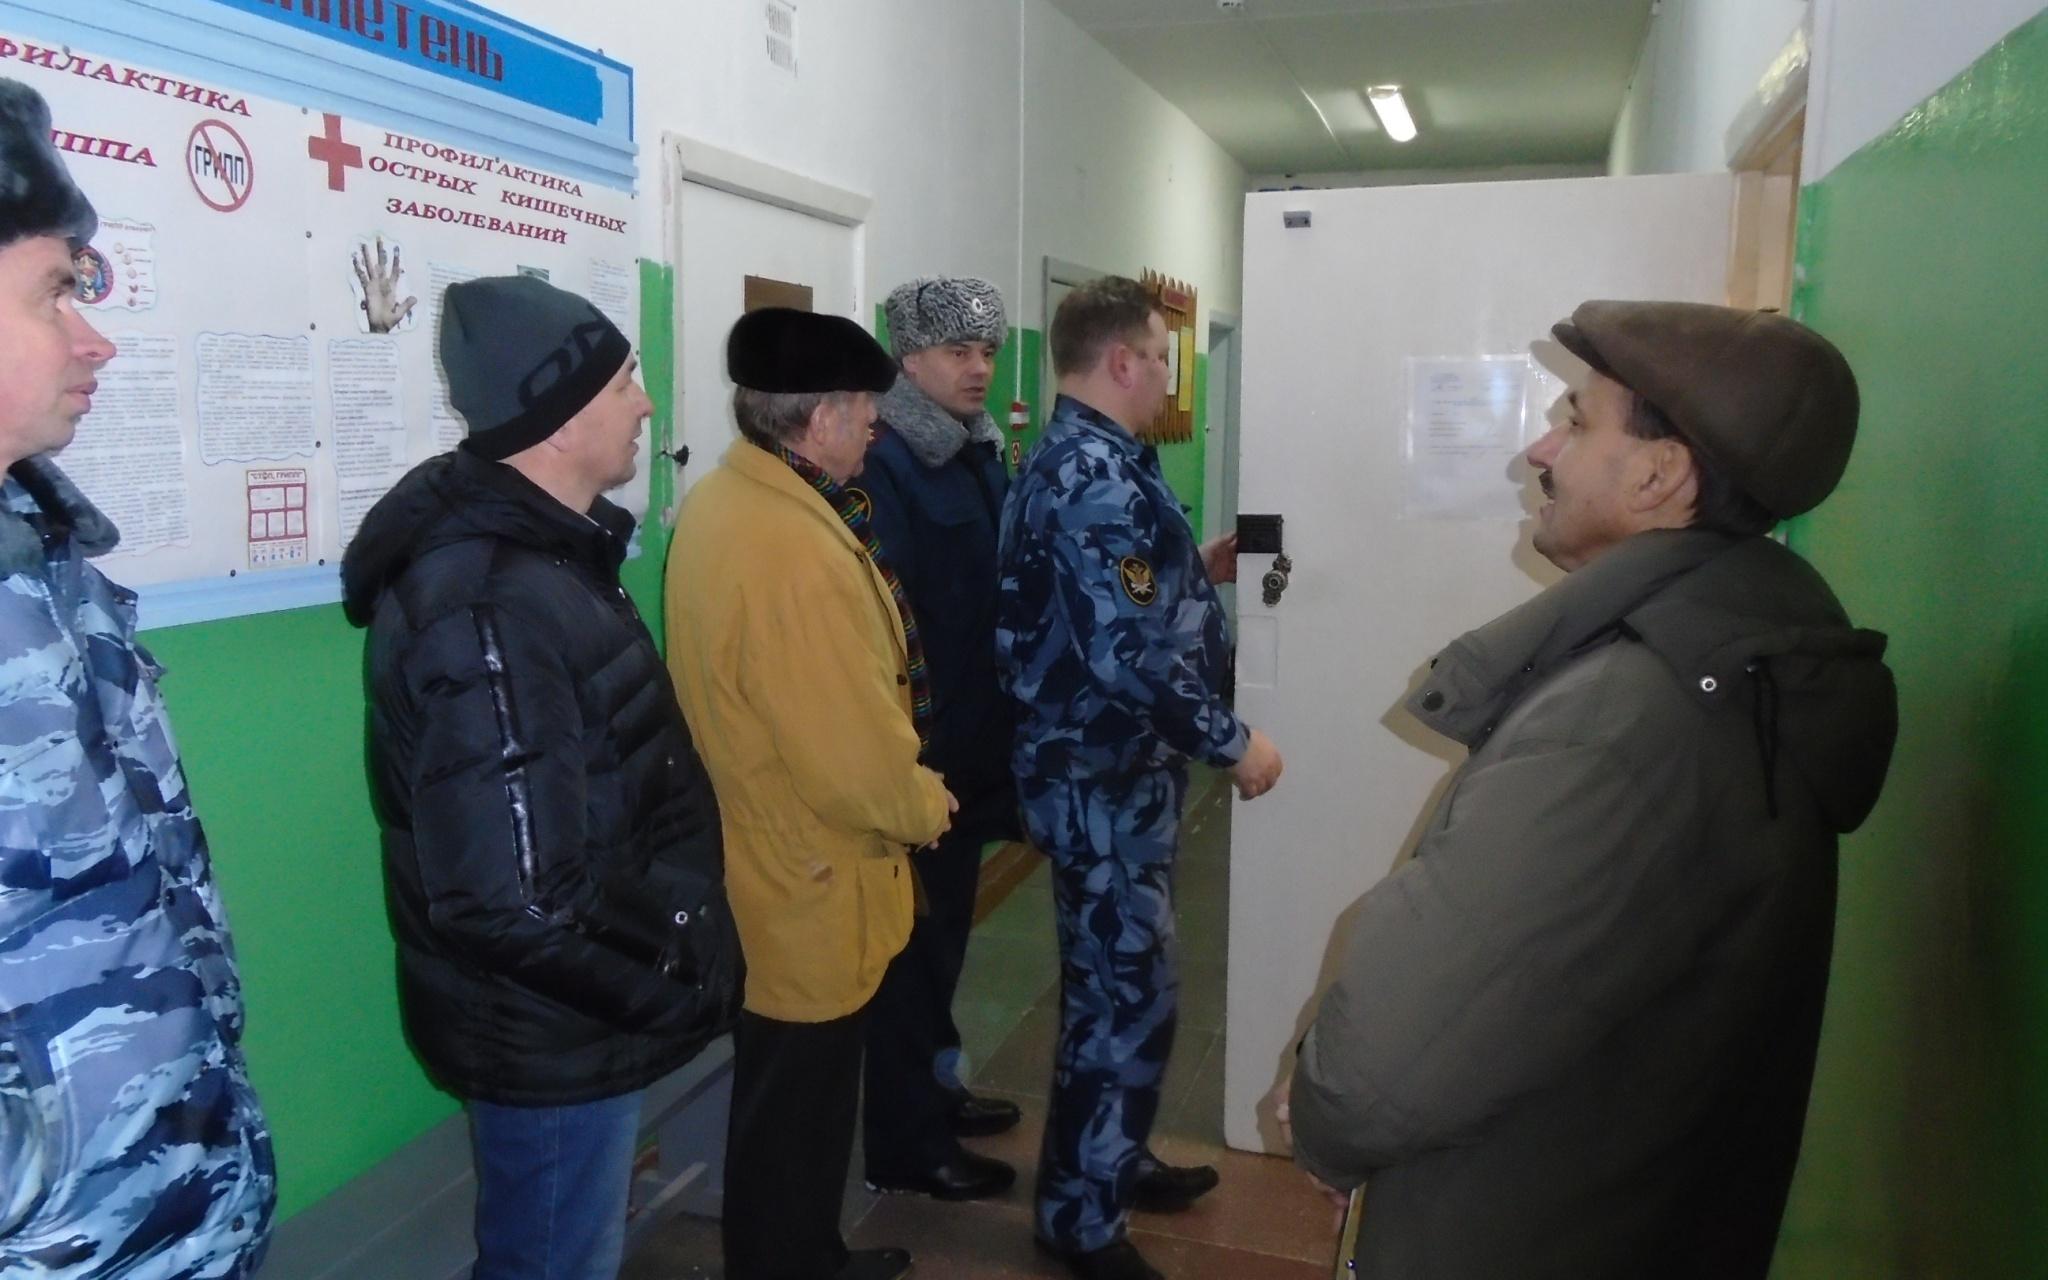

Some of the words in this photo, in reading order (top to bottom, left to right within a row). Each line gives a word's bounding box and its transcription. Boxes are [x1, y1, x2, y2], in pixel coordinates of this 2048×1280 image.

[194, 144, 245, 186] ГРИПП
[383, 131, 583, 198] ПРОФИЛАКТИКА
[368, 155, 478, 196] ОСТРЫХ
[500, 189, 628, 234] КИШЕЧНЫХ
[385, 197, 568, 245] ЗАБОЛЕВАНИЙ
